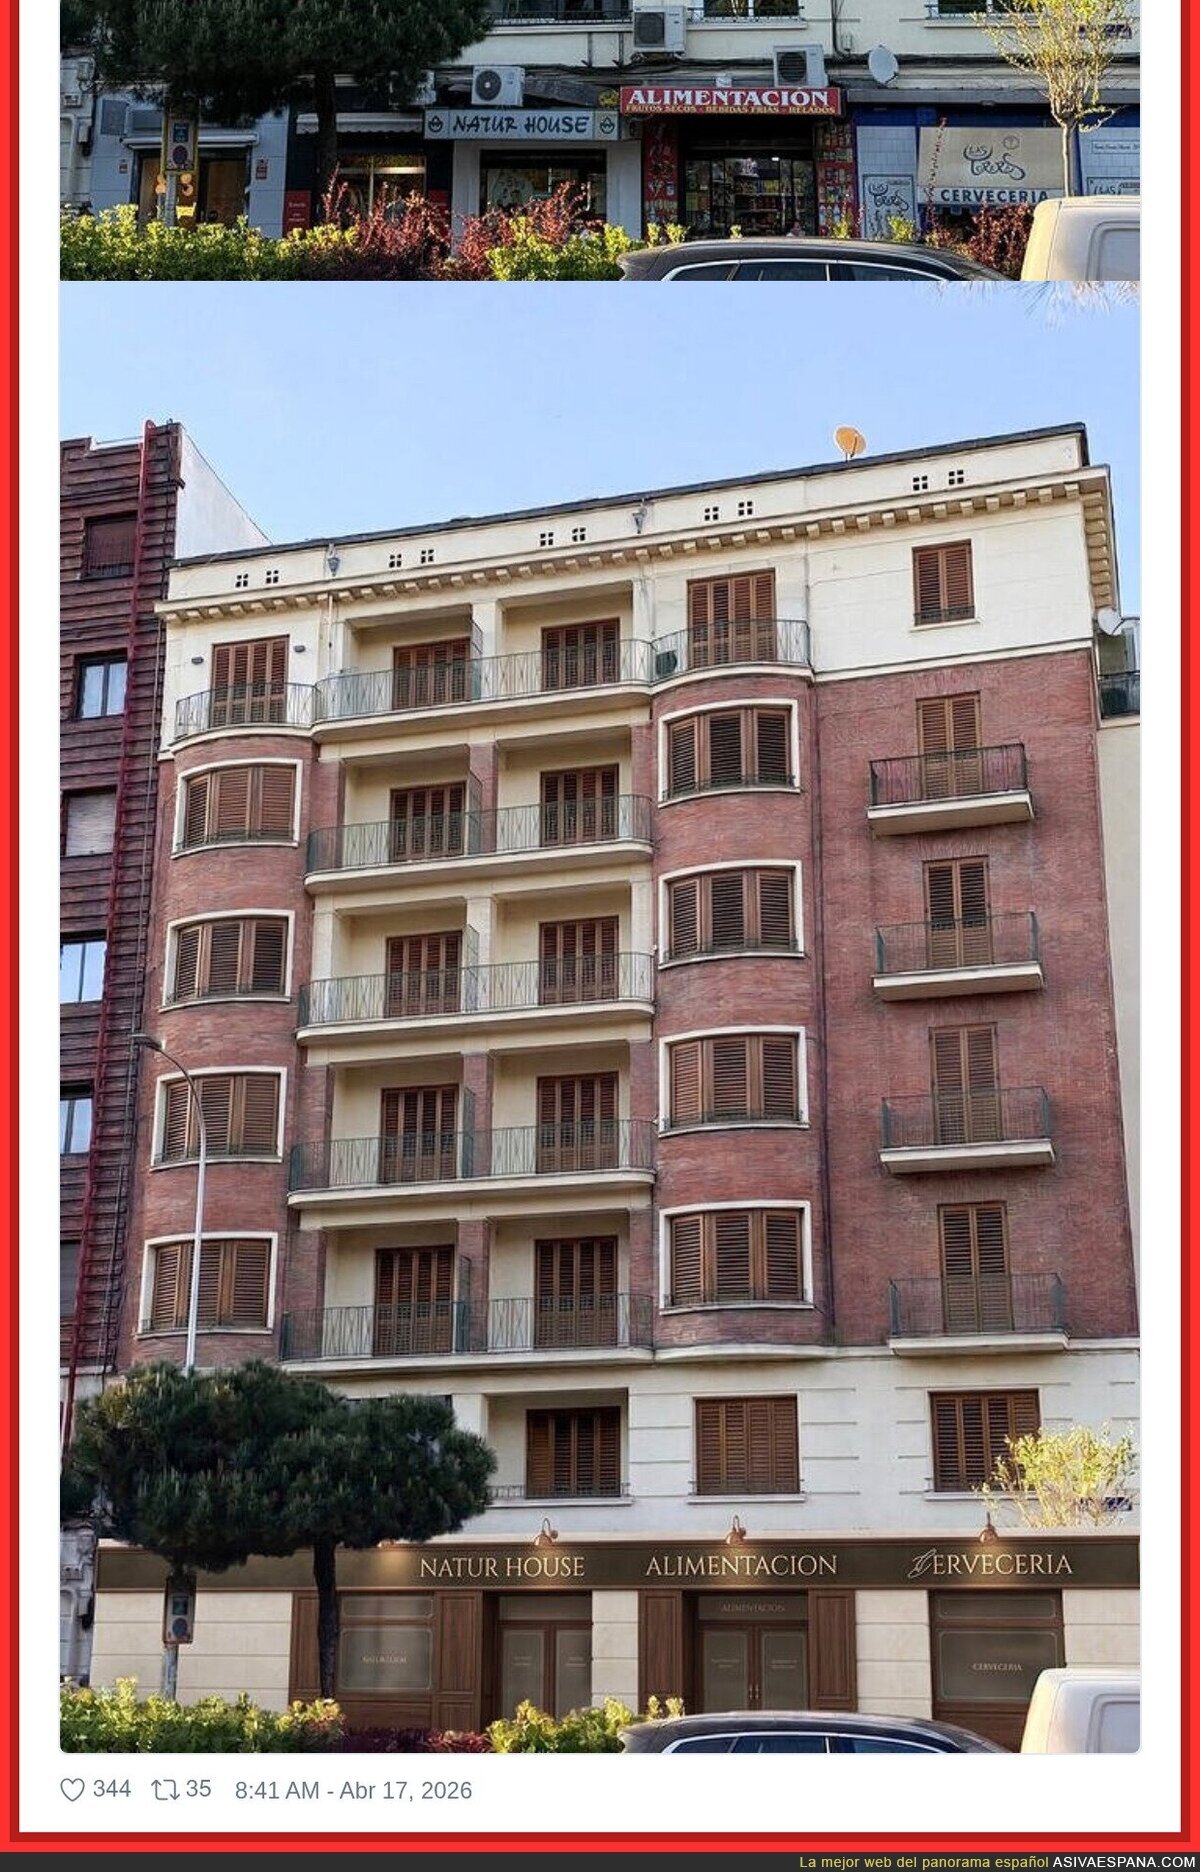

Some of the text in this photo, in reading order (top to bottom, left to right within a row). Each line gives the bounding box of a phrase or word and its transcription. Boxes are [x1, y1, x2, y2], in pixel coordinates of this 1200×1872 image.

[453, 115, 590, 134] NATUR HOUSE
[420, 1556, 585, 1578] NATUR HOUSE
[646, 1555, 837, 1577] ALIMENTACION
